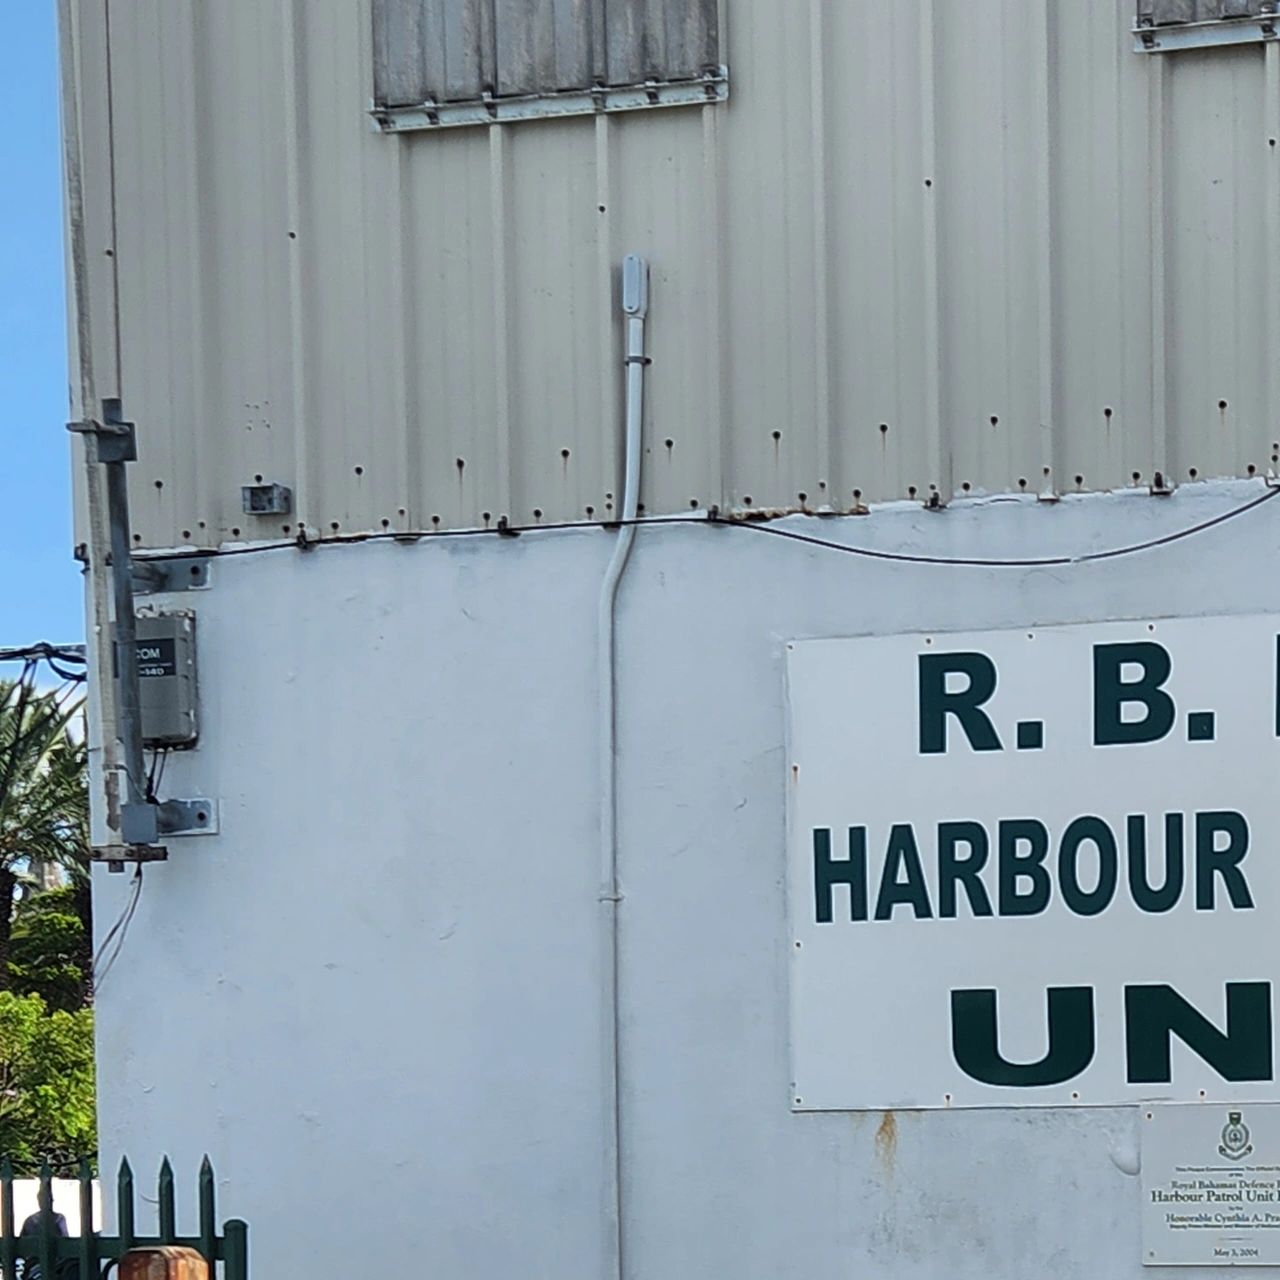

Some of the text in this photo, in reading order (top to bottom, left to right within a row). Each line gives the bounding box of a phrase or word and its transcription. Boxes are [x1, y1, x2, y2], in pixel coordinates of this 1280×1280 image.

[136, 647, 160, 659] COM
[918, 652, 1043, 754] R.
[1093, 641, 1215, 746] B.
[813, 811, 1255, 923] HARBOUR
[1171, 1181, 1196, 1191] Royal
[1198, 1181, 1237, 1189] Bahamas
[1239, 1180, 1274, 1189] Defence
[1151, 1191, 1203, 1202] Harbour
[1206, 1190, 1243, 1202] Patrol
[1246, 1190, 1274, 1202] Unit
[1165, 1213, 1212, 1222] Honorable
[1214, 1213, 1250, 1225] Cynthia
[1252, 1214, 1263, 1222] A.
[1214, 1248, 1229, 1257] May
